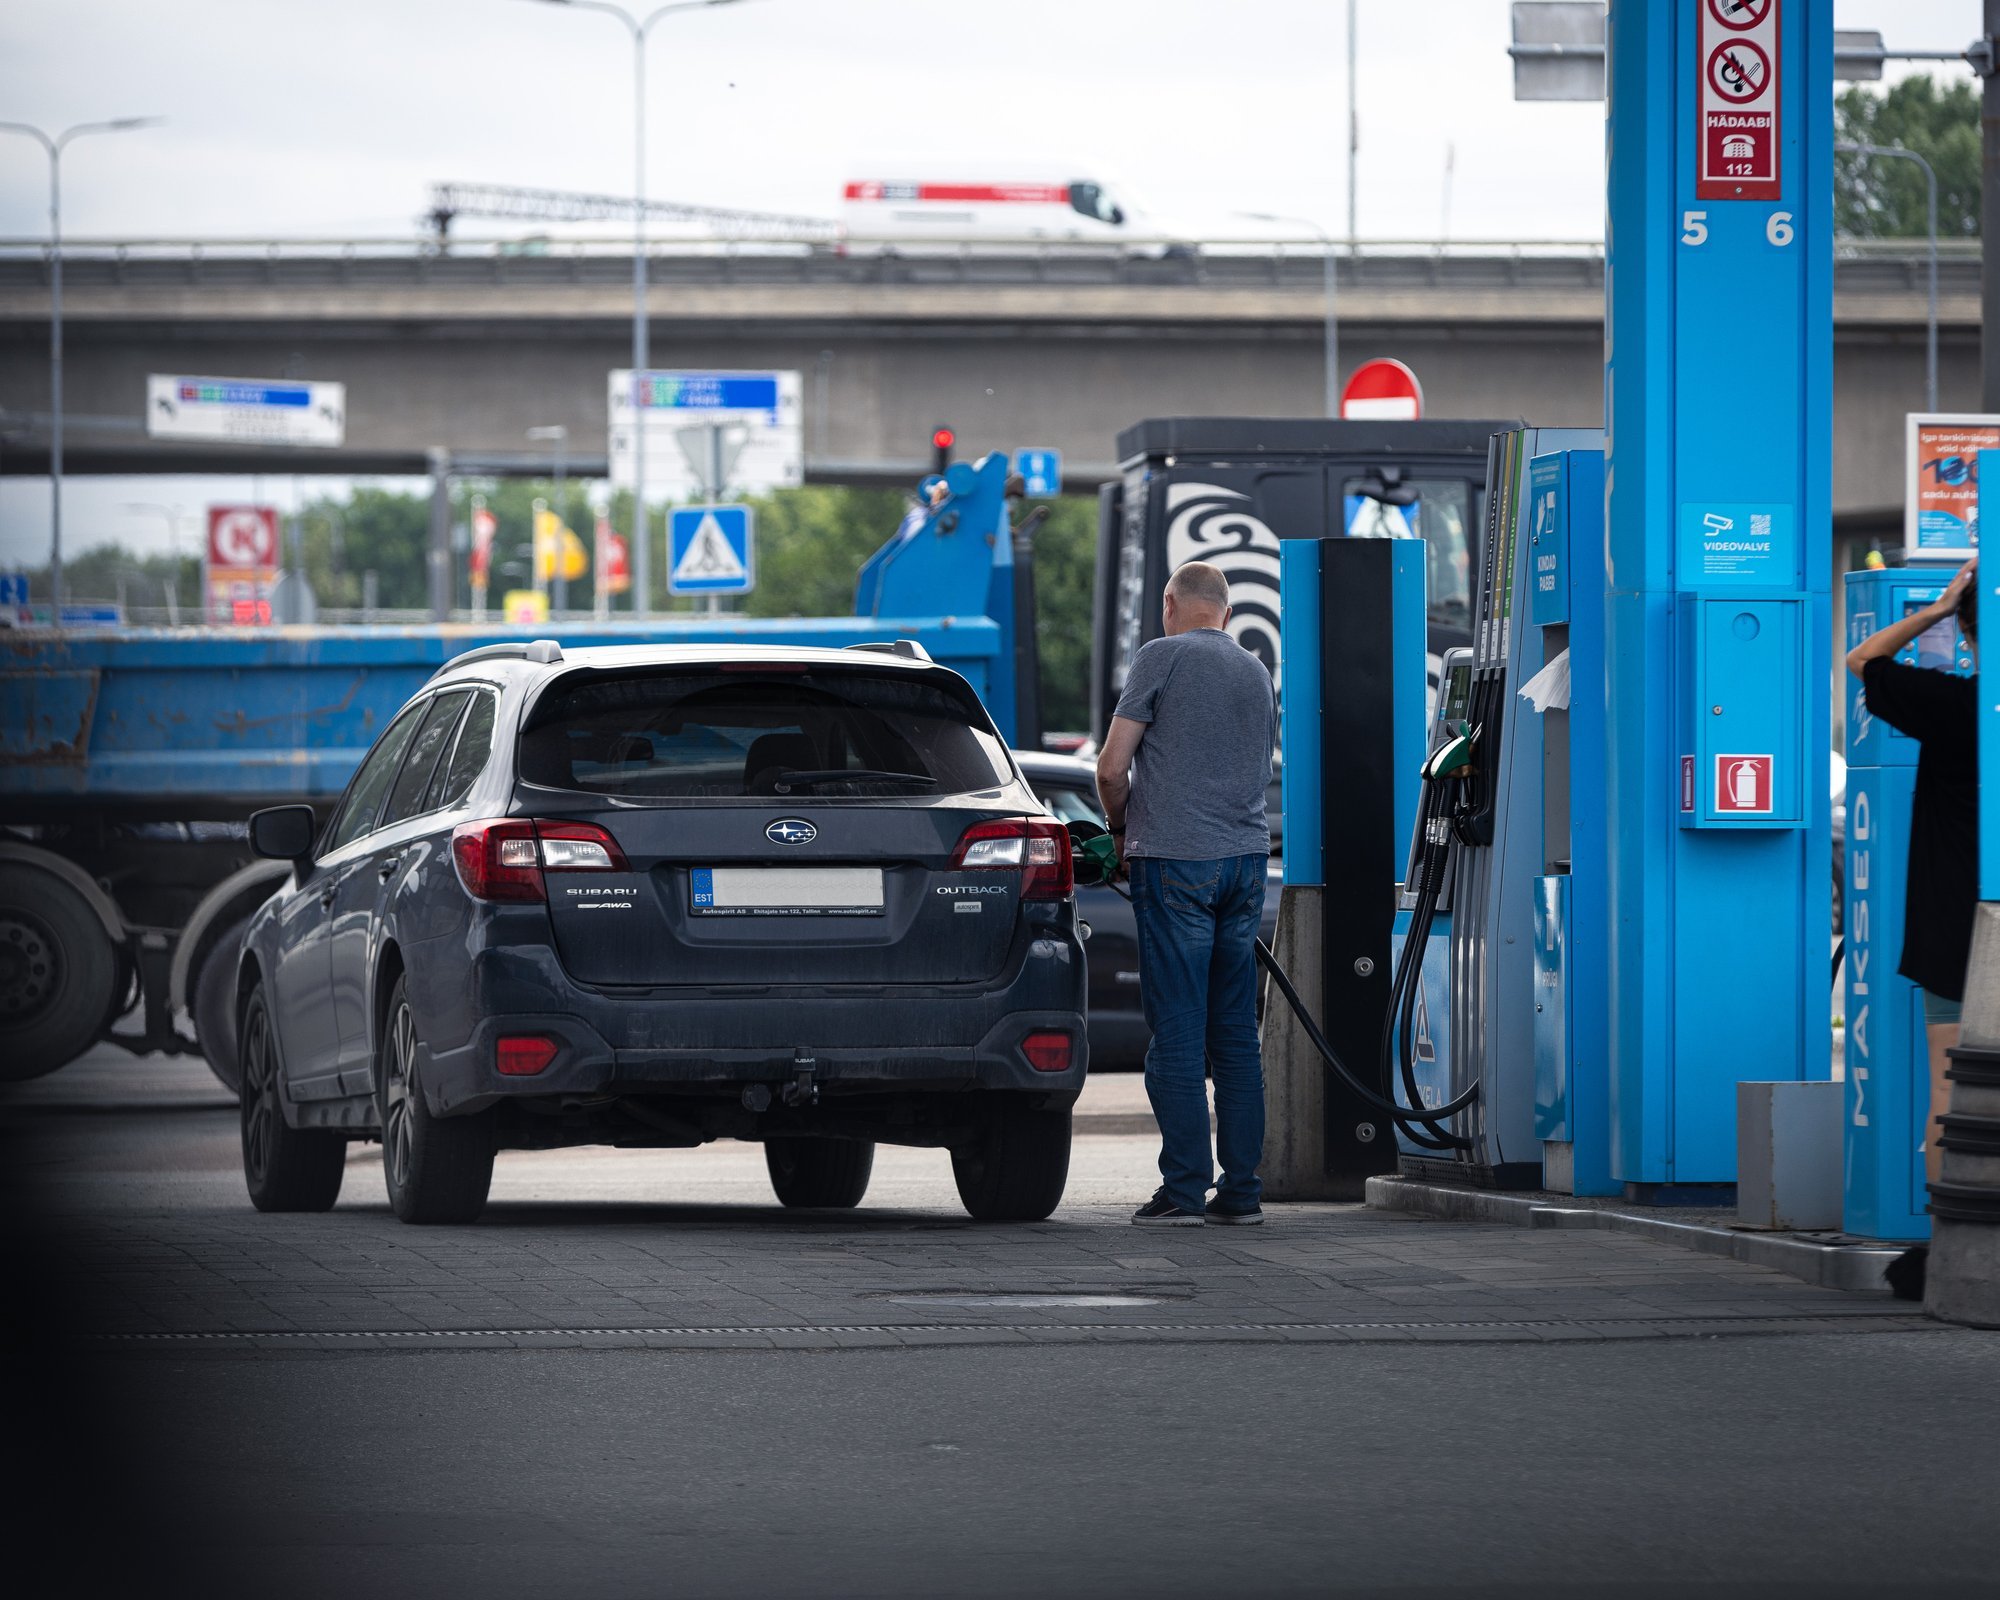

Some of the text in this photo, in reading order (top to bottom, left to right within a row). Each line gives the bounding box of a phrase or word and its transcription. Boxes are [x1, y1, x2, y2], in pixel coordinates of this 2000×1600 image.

[1708, 115, 1771, 128] HÄDAABI
[1726, 164, 1753, 175] 112
[1681, 211, 1794, 247] 5 6
[1703, 542, 1771, 551] VIDEOVALVE
[1537, 554, 1556, 572] KINDAD
[1539, 575, 1556, 592] PABER
[936, 886, 1008, 895] OUTBACK
[695, 893, 713, 903] EST
[1853, 790, 1869, 1127] MAKSED
